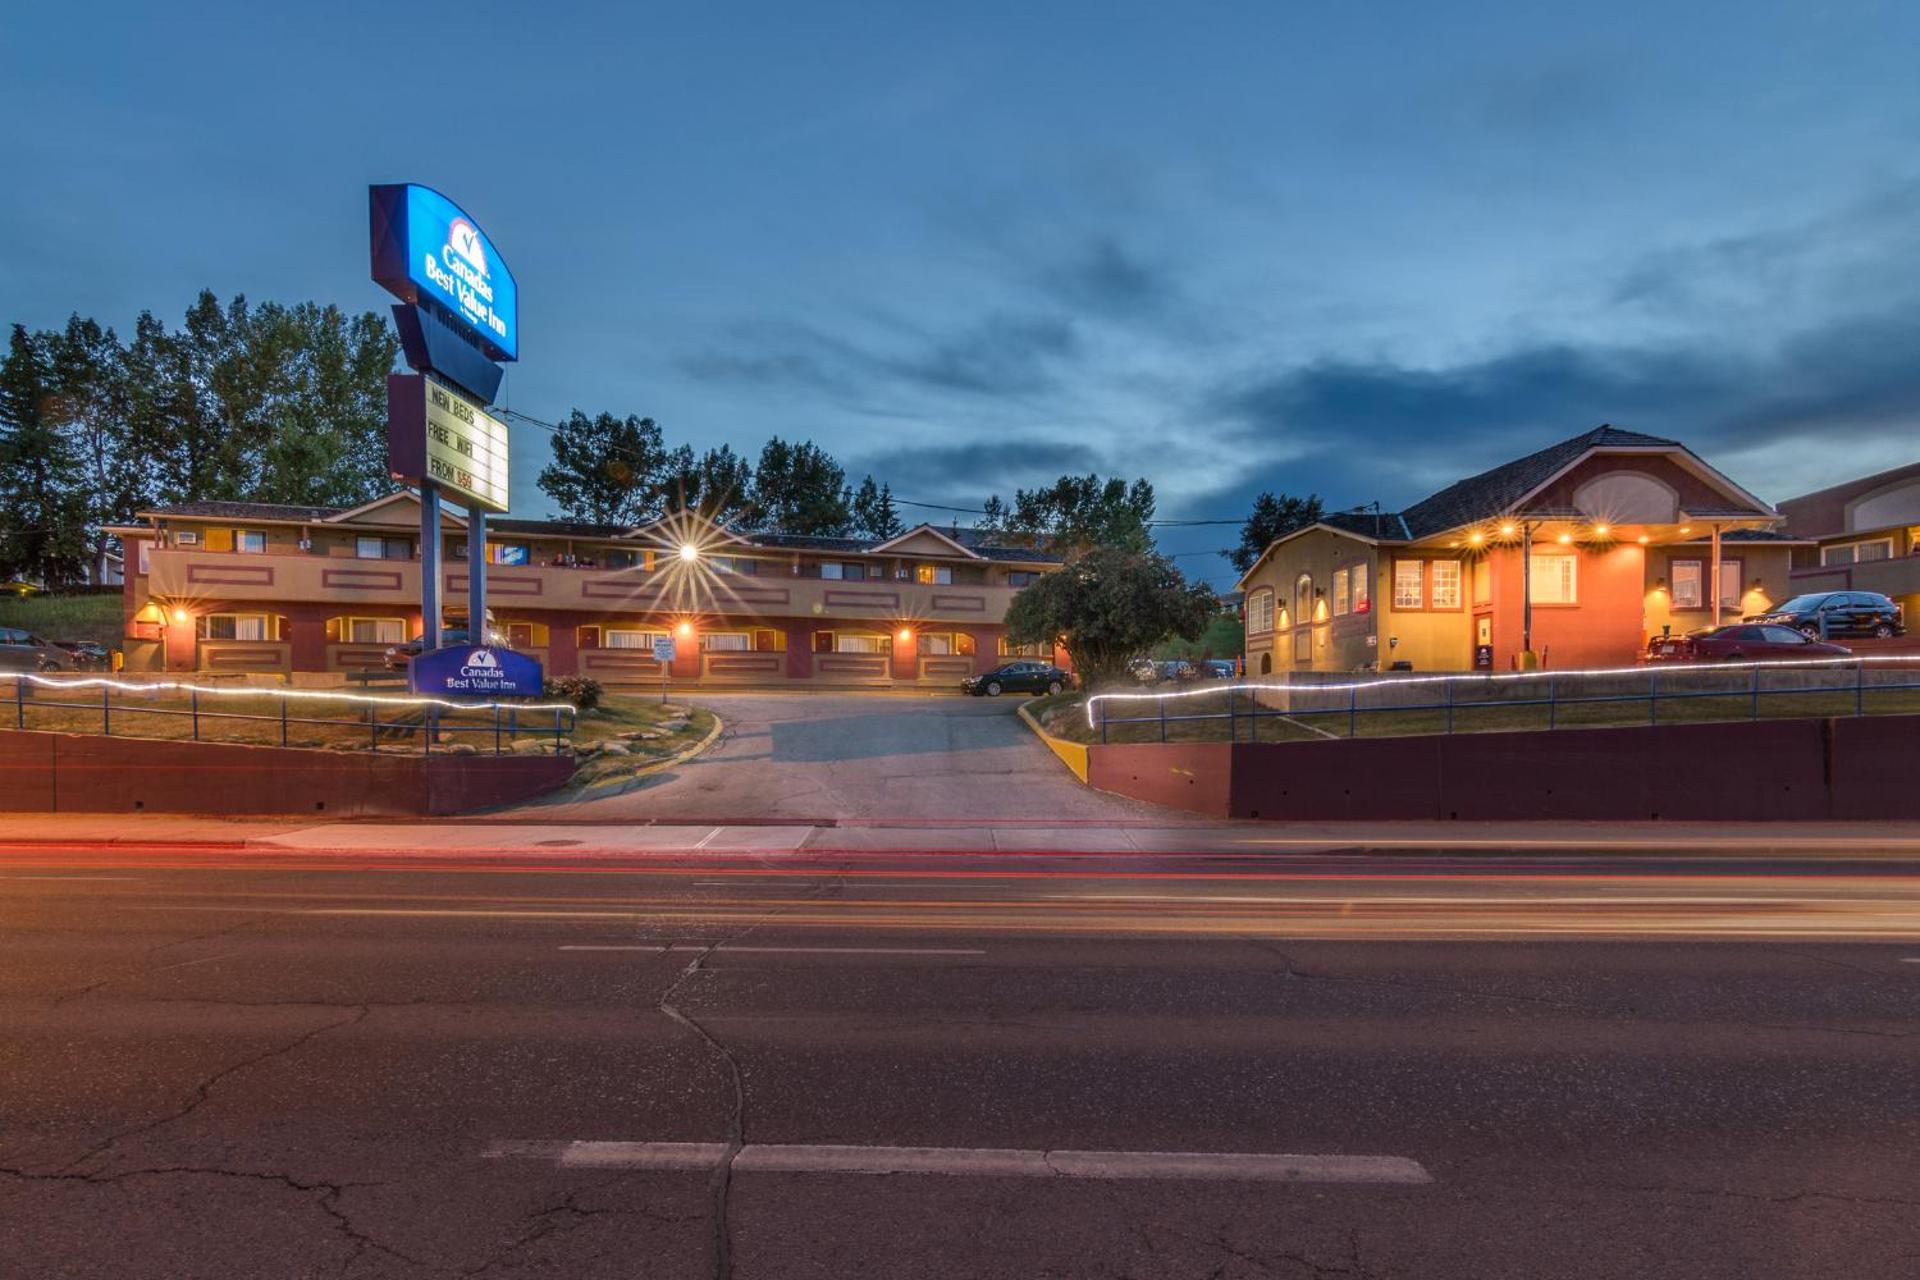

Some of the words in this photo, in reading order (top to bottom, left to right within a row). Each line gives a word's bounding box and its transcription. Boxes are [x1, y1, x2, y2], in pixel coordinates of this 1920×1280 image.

[443, 244, 493, 303] Canadas
[425, 253, 455, 295] Best
[457, 278, 488, 322] Value
[488, 306, 507, 337] Inn
[432, 386, 450, 412] NEW
[453, 400, 475, 425] BEDS
[428, 421, 449, 446] FREE
[431, 459, 454, 481] FROM
[447, 677, 469, 689] Best
[472, 678, 499, 689] Value
[500, 679, 516, 690] Inn
[460, 666, 504, 678] Canadas
